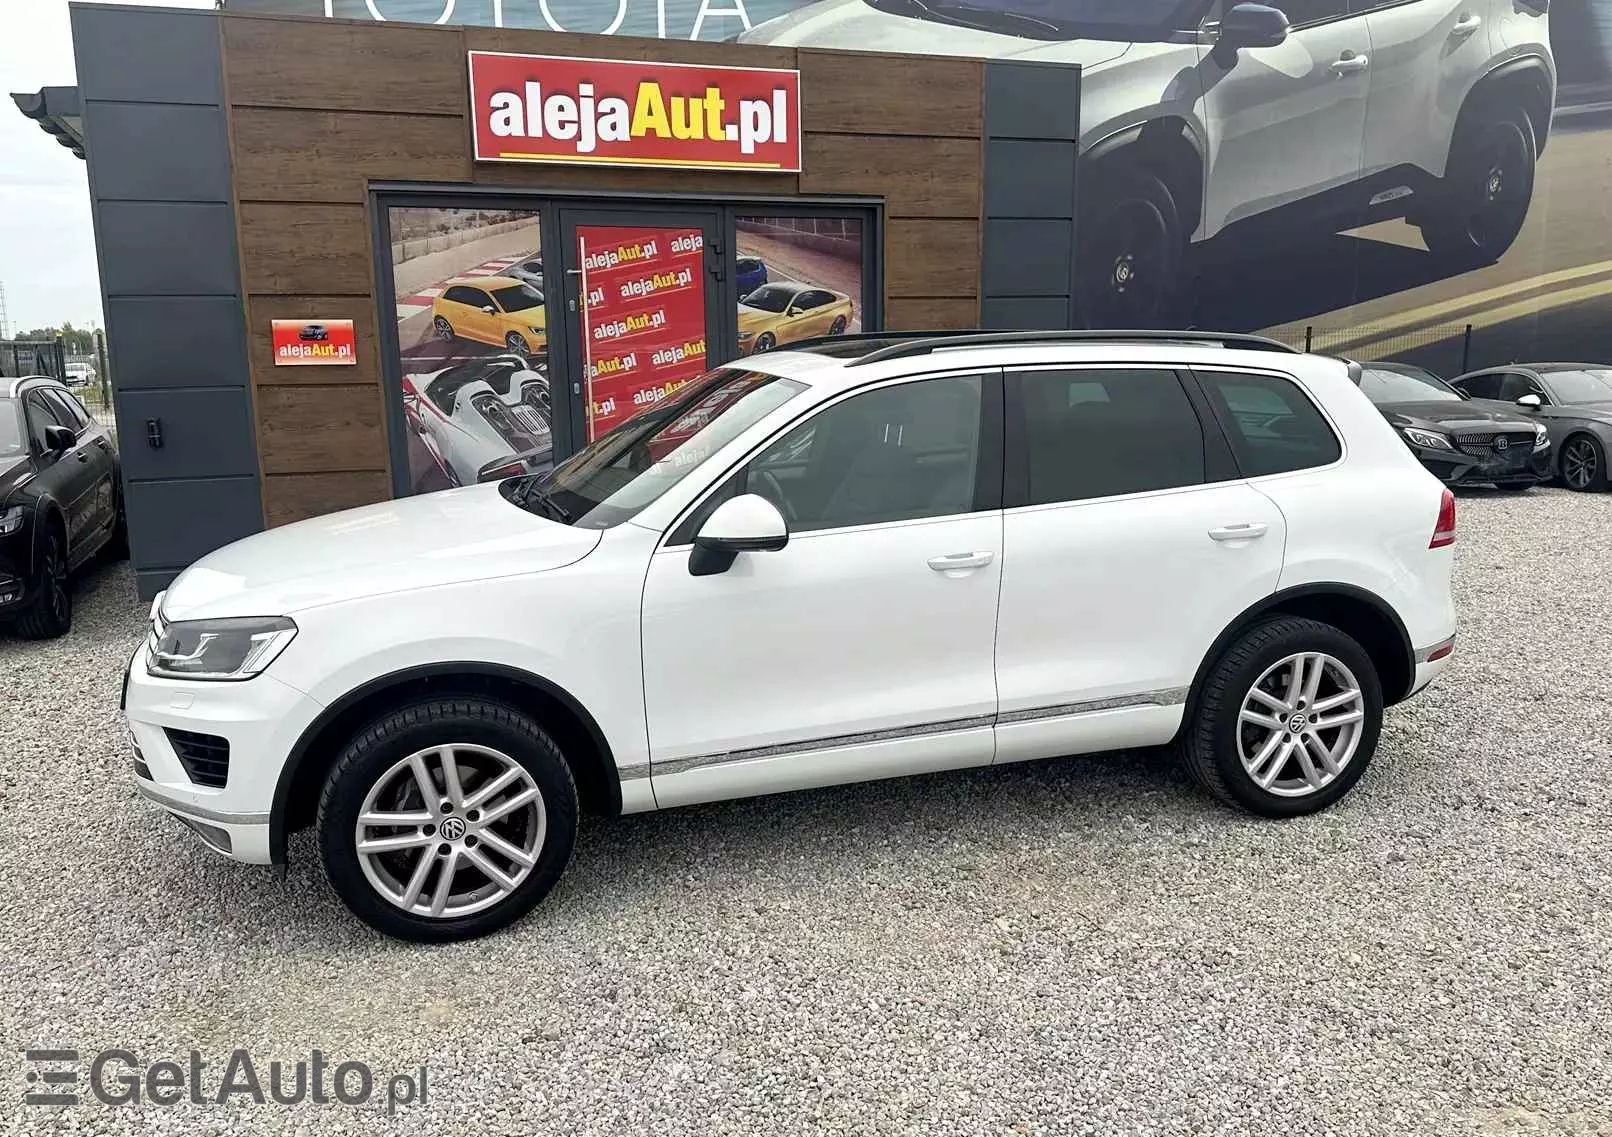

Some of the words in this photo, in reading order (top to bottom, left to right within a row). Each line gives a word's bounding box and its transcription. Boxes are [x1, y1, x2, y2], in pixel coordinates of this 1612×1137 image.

[489, 81, 787, 154] alejaAut.pl
[585, 240, 658, 268] alejaAut.pl
[620, 268, 692, 297] alejaAut.pl
[593, 310, 665, 339] alejaAut.pl
[279, 343, 350, 358] alejaAut.pl
